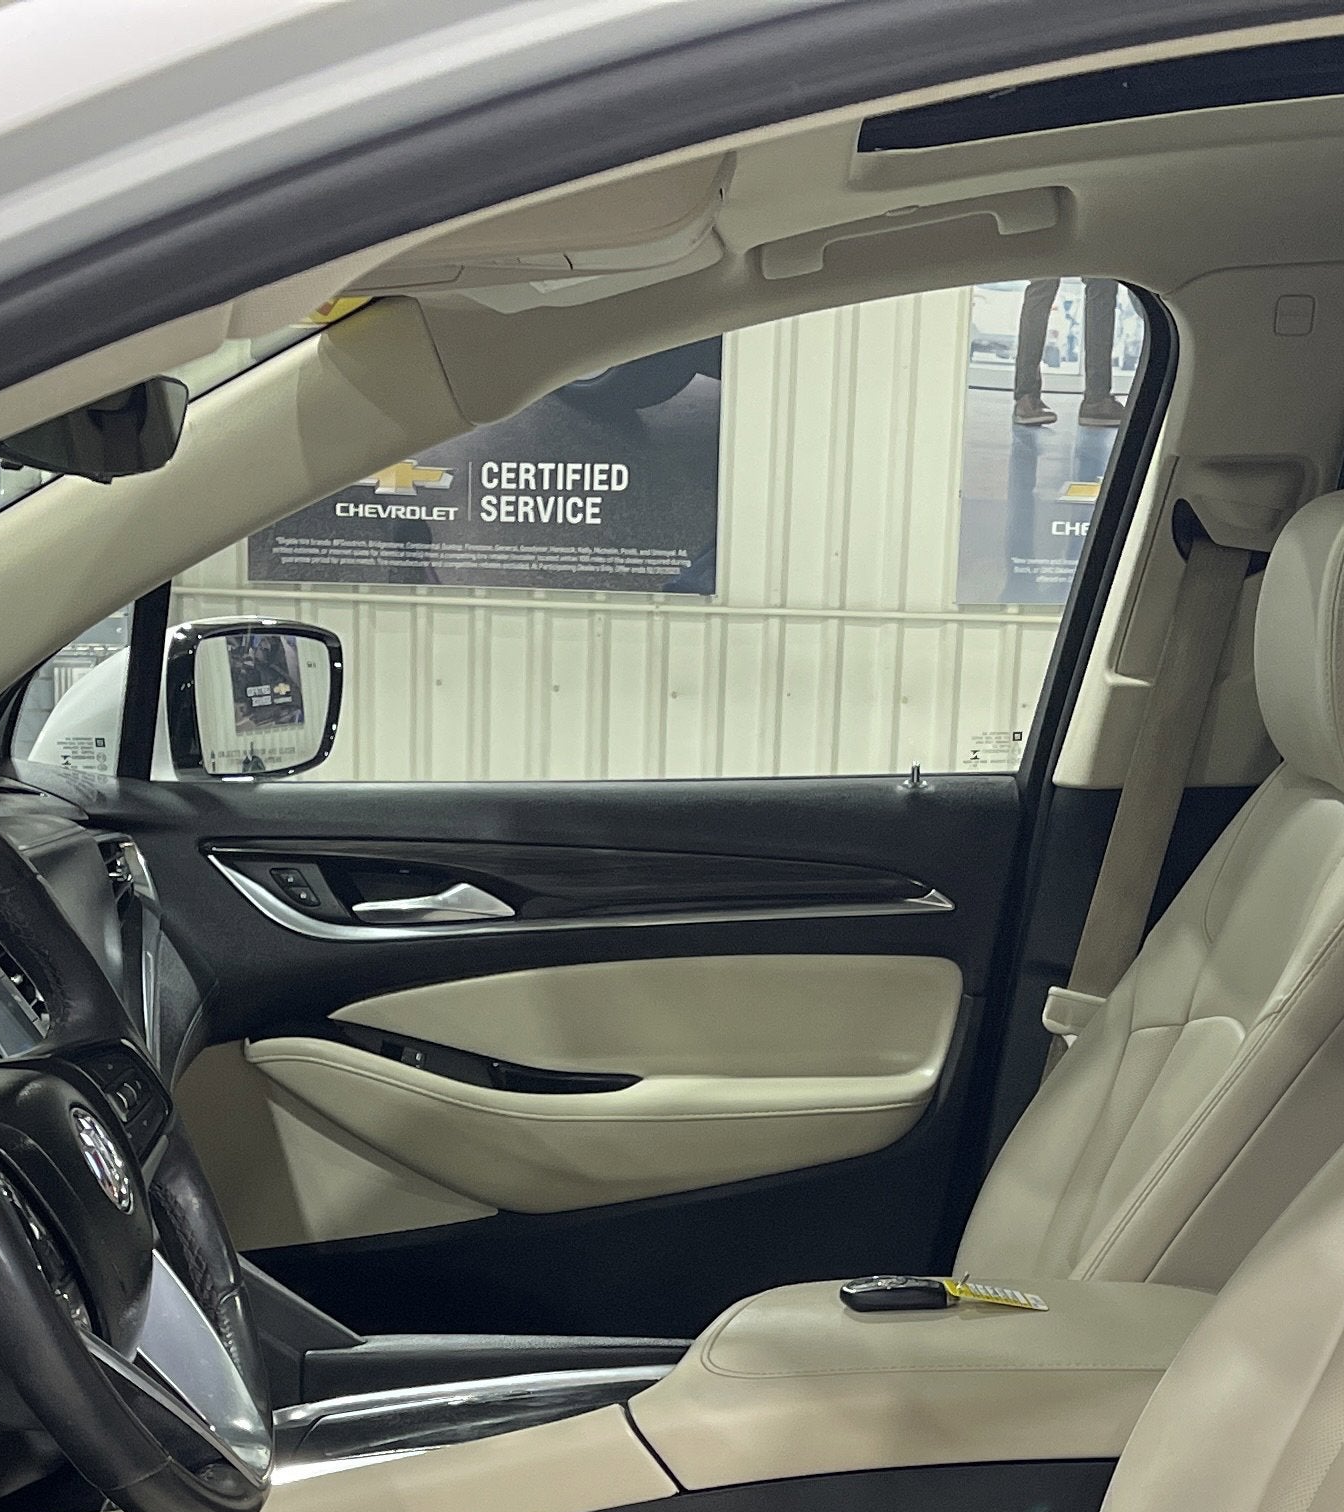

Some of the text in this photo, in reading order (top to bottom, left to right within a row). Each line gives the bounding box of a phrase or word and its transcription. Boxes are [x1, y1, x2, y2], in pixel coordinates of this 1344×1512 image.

[480, 461, 629, 492] CERTIFIED
[335, 502, 459, 521] CHEVROLET
[479, 495, 603, 525] SERVICE
